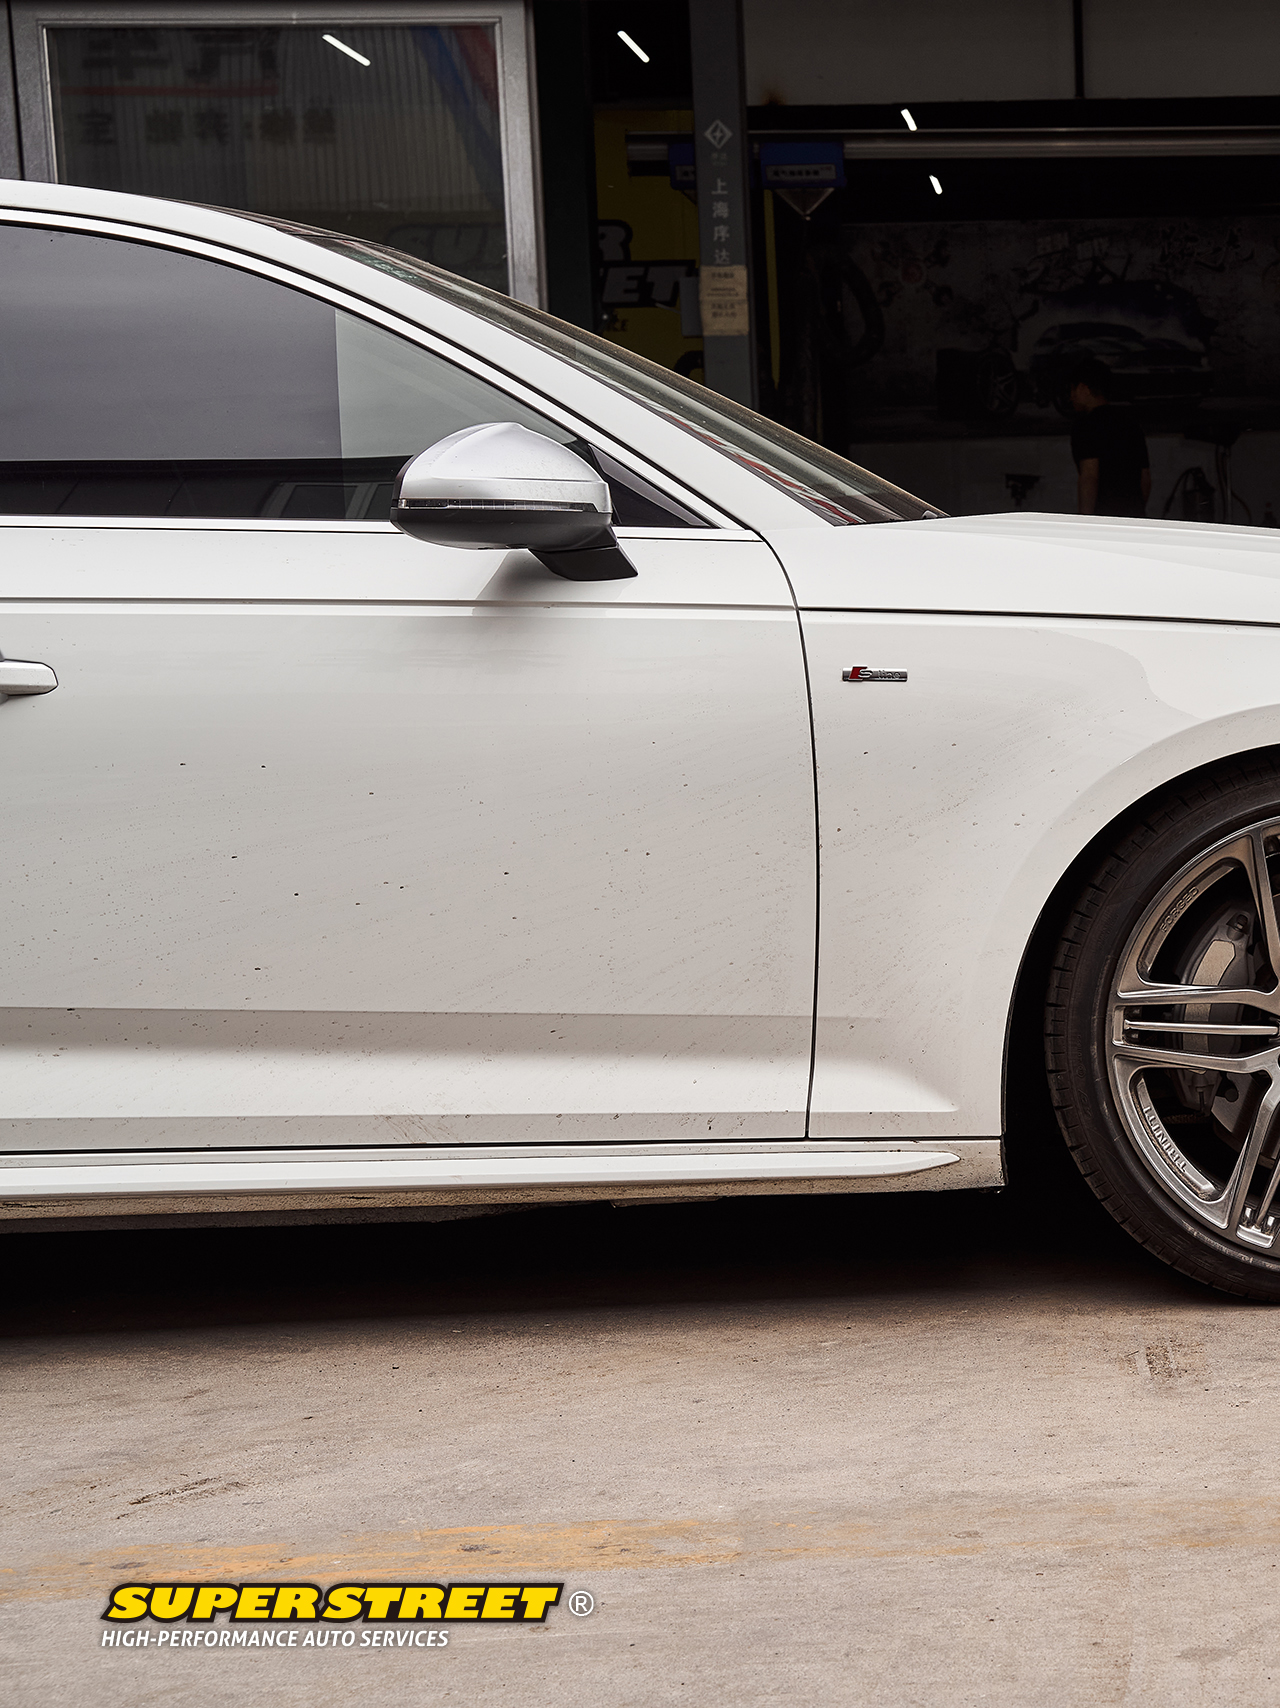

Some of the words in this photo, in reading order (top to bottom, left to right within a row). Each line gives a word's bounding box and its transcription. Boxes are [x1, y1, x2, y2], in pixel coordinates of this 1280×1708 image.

[710, 178, 731, 266] 上海序达
[1160, 886, 1200, 933] FORGED
